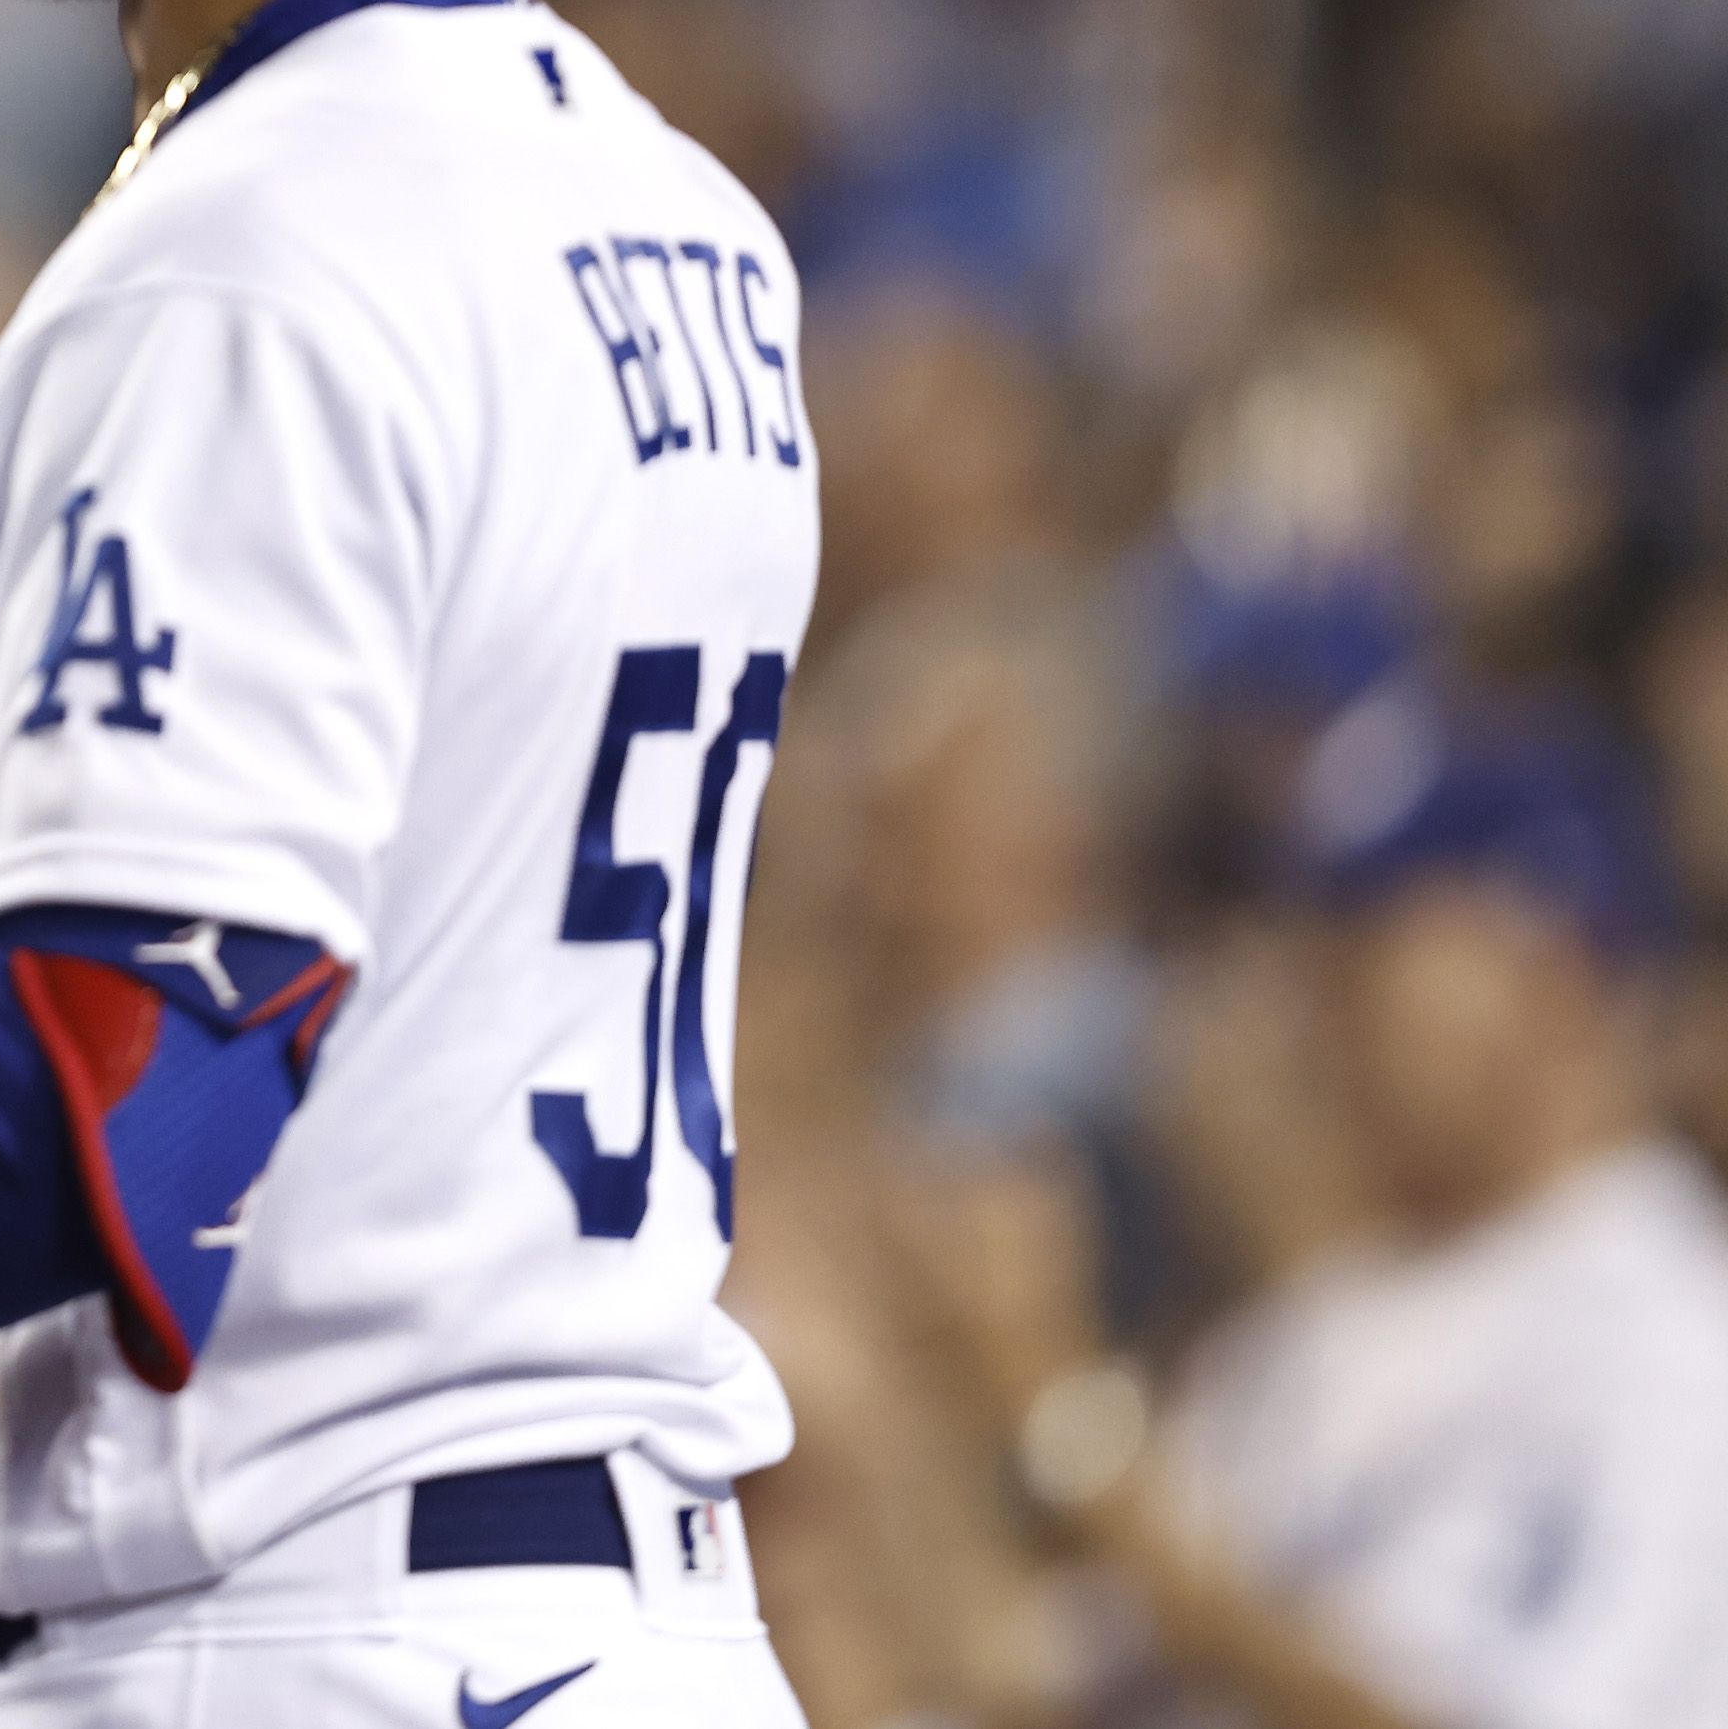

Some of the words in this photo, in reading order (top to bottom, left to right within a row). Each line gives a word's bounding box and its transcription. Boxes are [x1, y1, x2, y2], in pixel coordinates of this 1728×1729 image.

[564, 238, 800, 468] BETTS
[19, 487, 176, 734] LA
[529, 642, 786, 1244] 50
